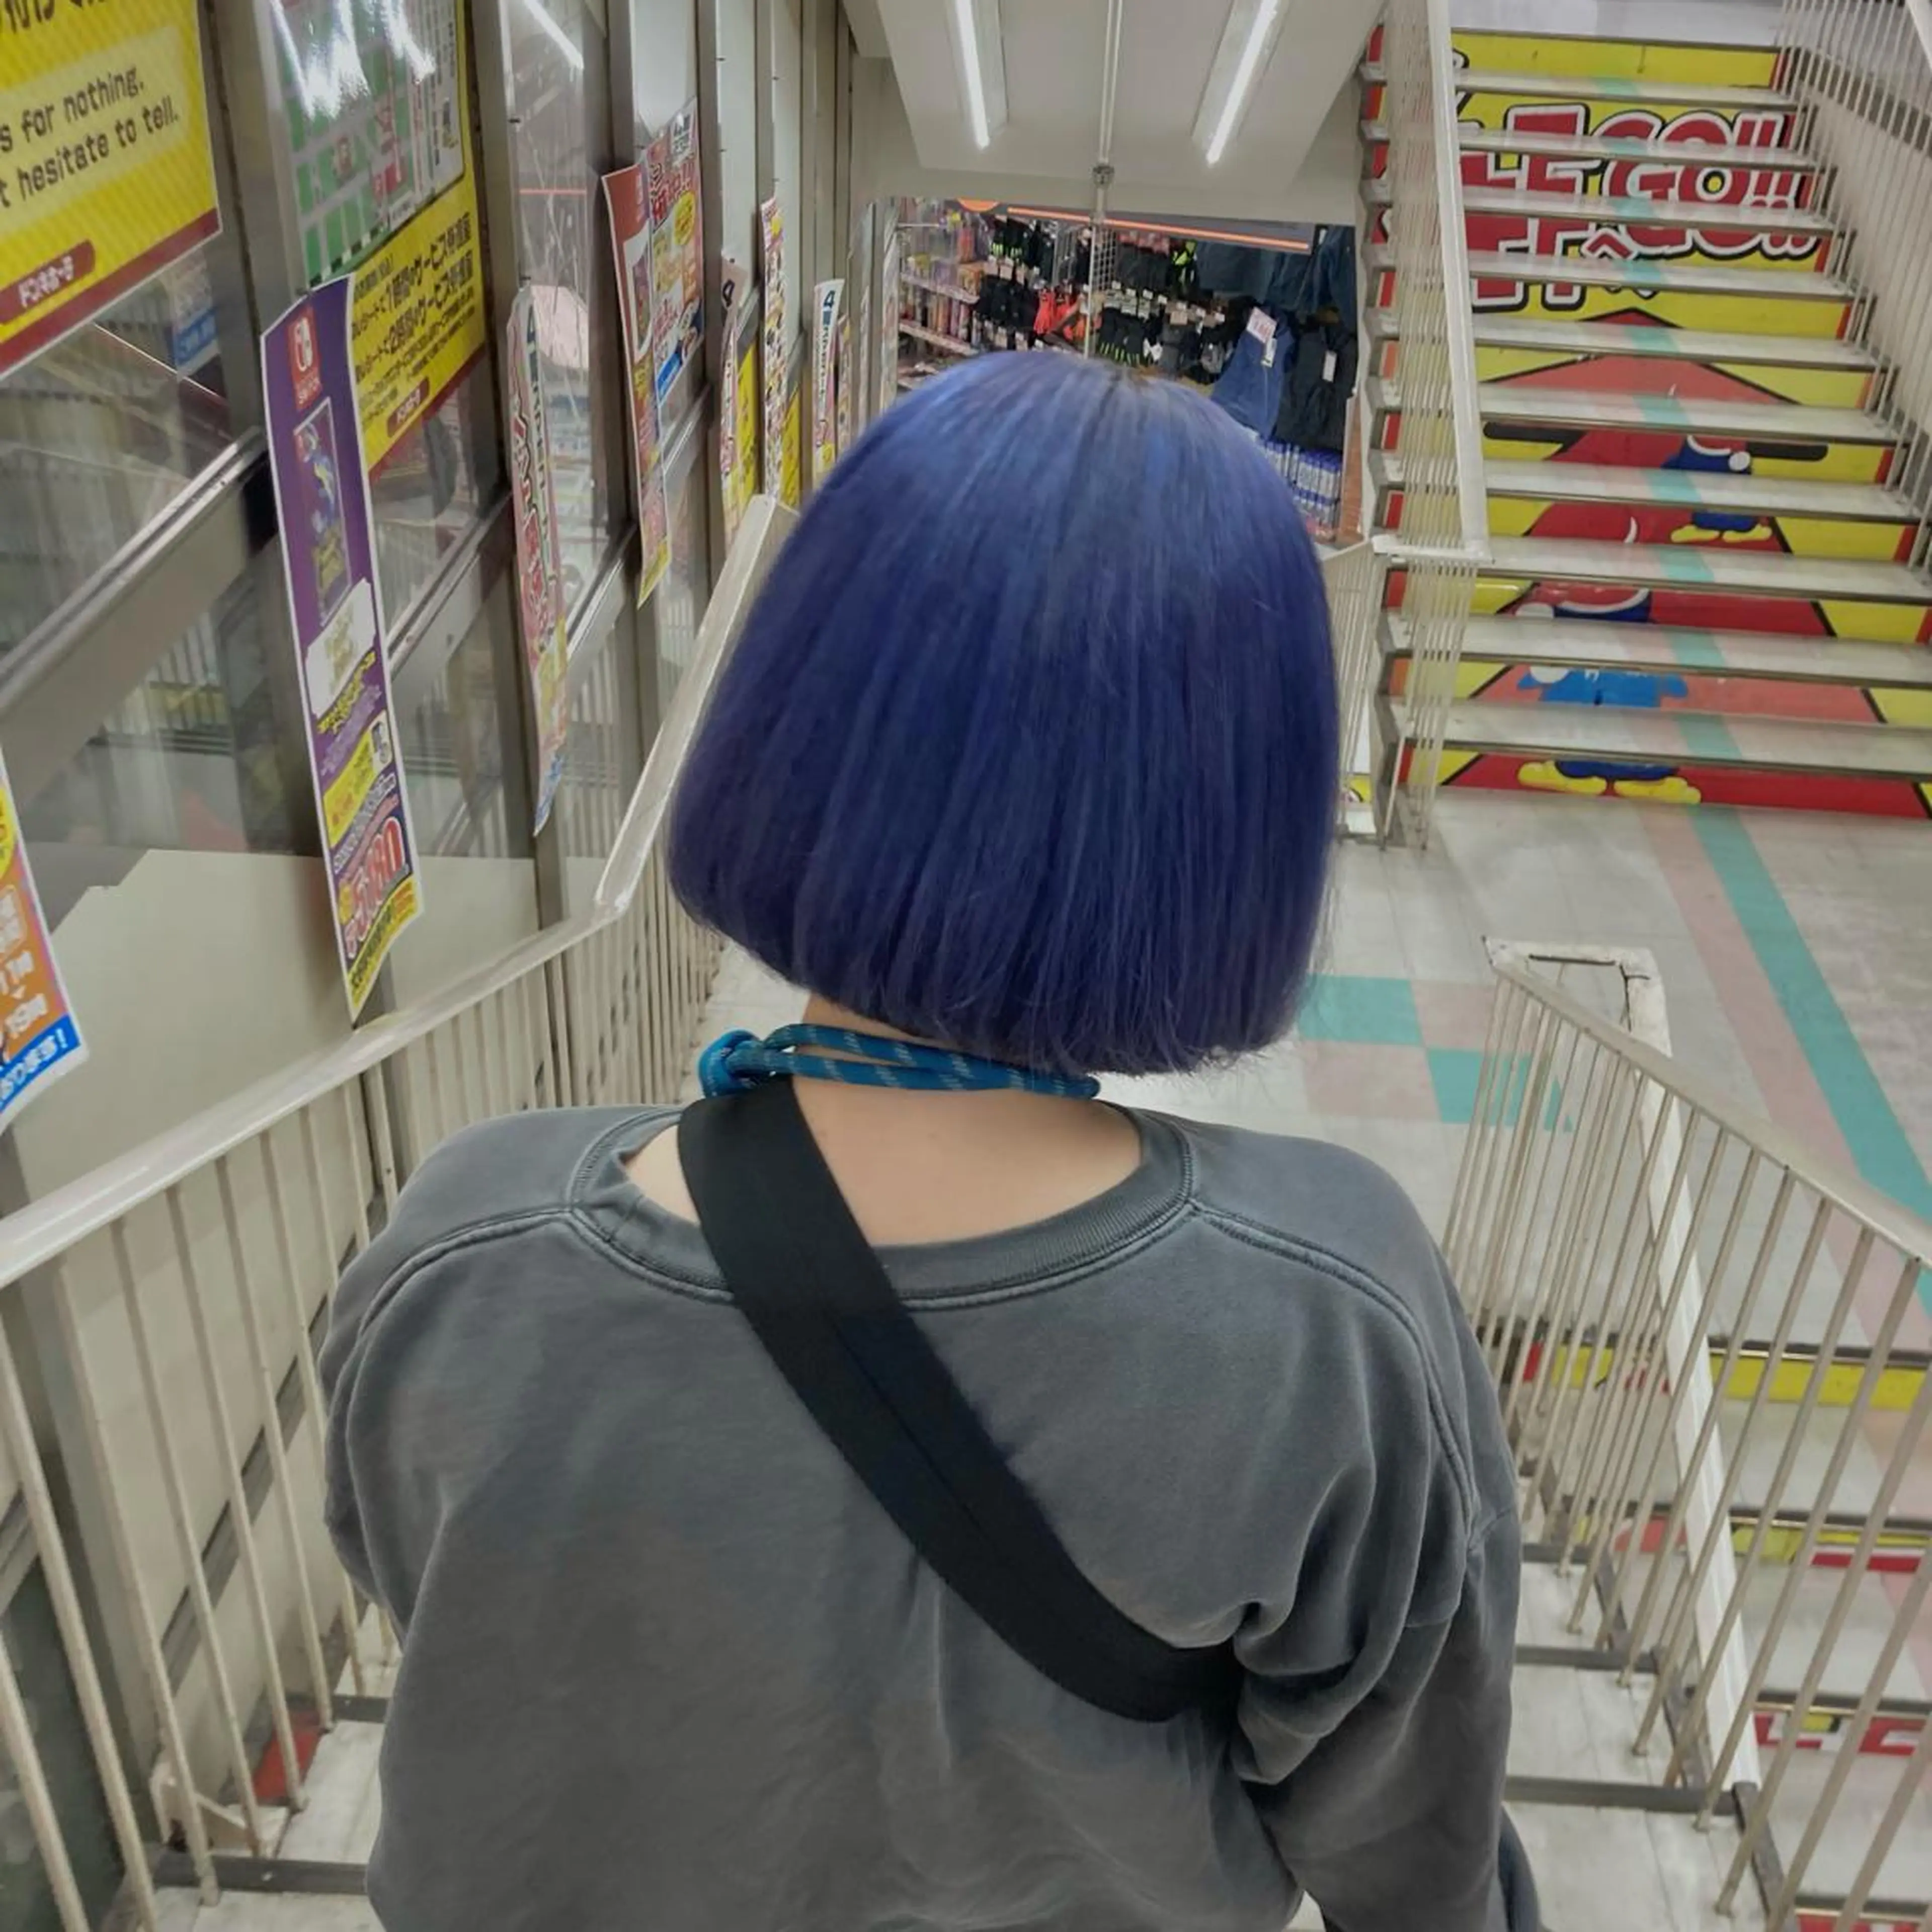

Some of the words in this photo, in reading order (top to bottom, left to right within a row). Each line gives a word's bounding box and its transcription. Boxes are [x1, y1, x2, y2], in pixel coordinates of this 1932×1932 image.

[17, 133, 110, 201] hesitate
[114, 117, 137, 148] to
[142, 95, 179, 134] tell.
[22, 104, 54, 143] for
[63, 64, 144, 124] nothing.
